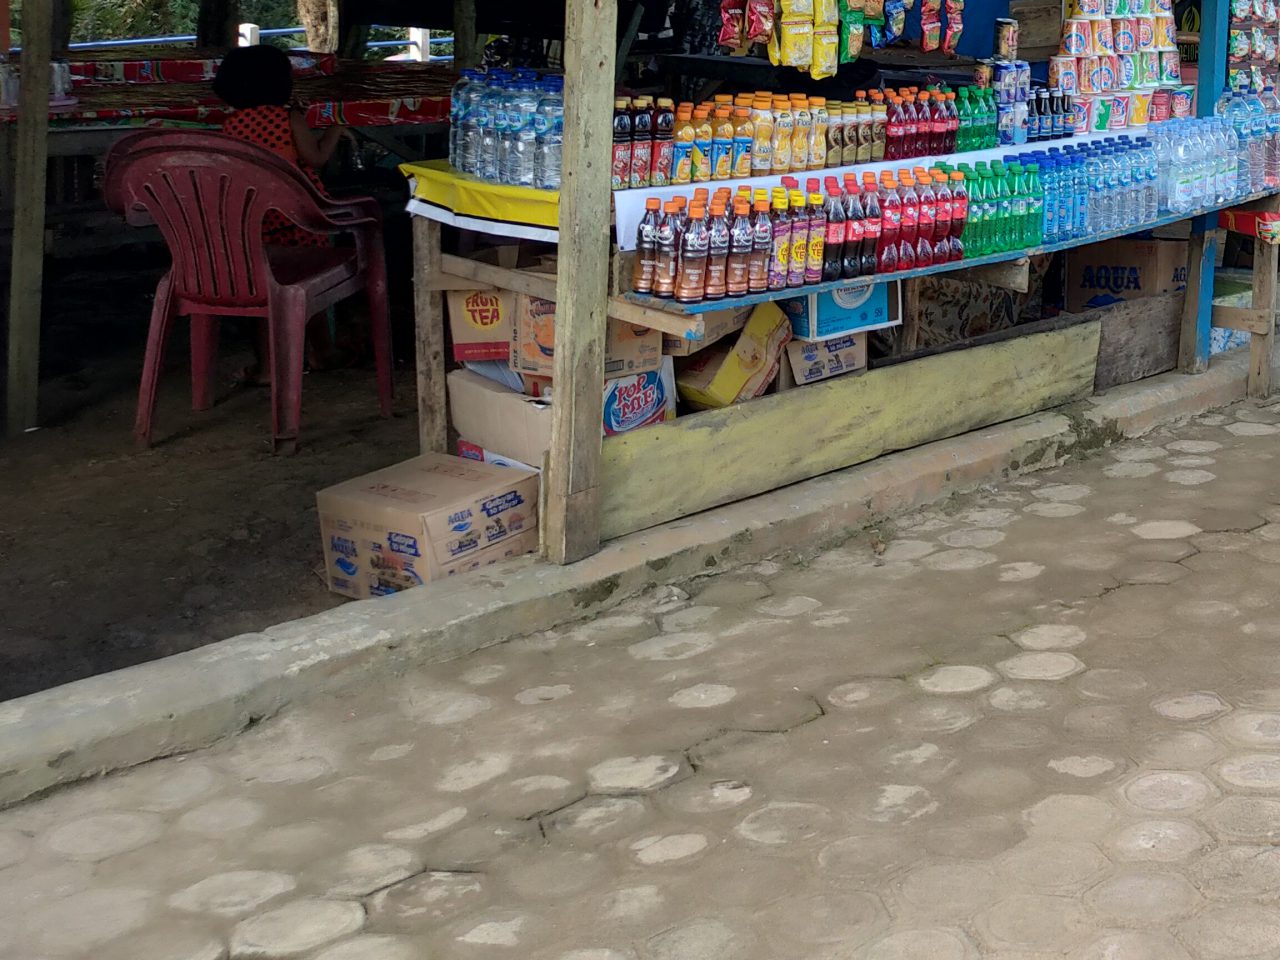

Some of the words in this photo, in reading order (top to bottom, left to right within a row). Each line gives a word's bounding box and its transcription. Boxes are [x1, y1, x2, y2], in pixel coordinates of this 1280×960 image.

[1080, 265, 1141, 294] AQUA
[465, 290, 500, 309] FRUIT
[466, 308, 500, 326] TEA
[615, 373, 648, 408] POP
[620, 385, 655, 420] MIE
